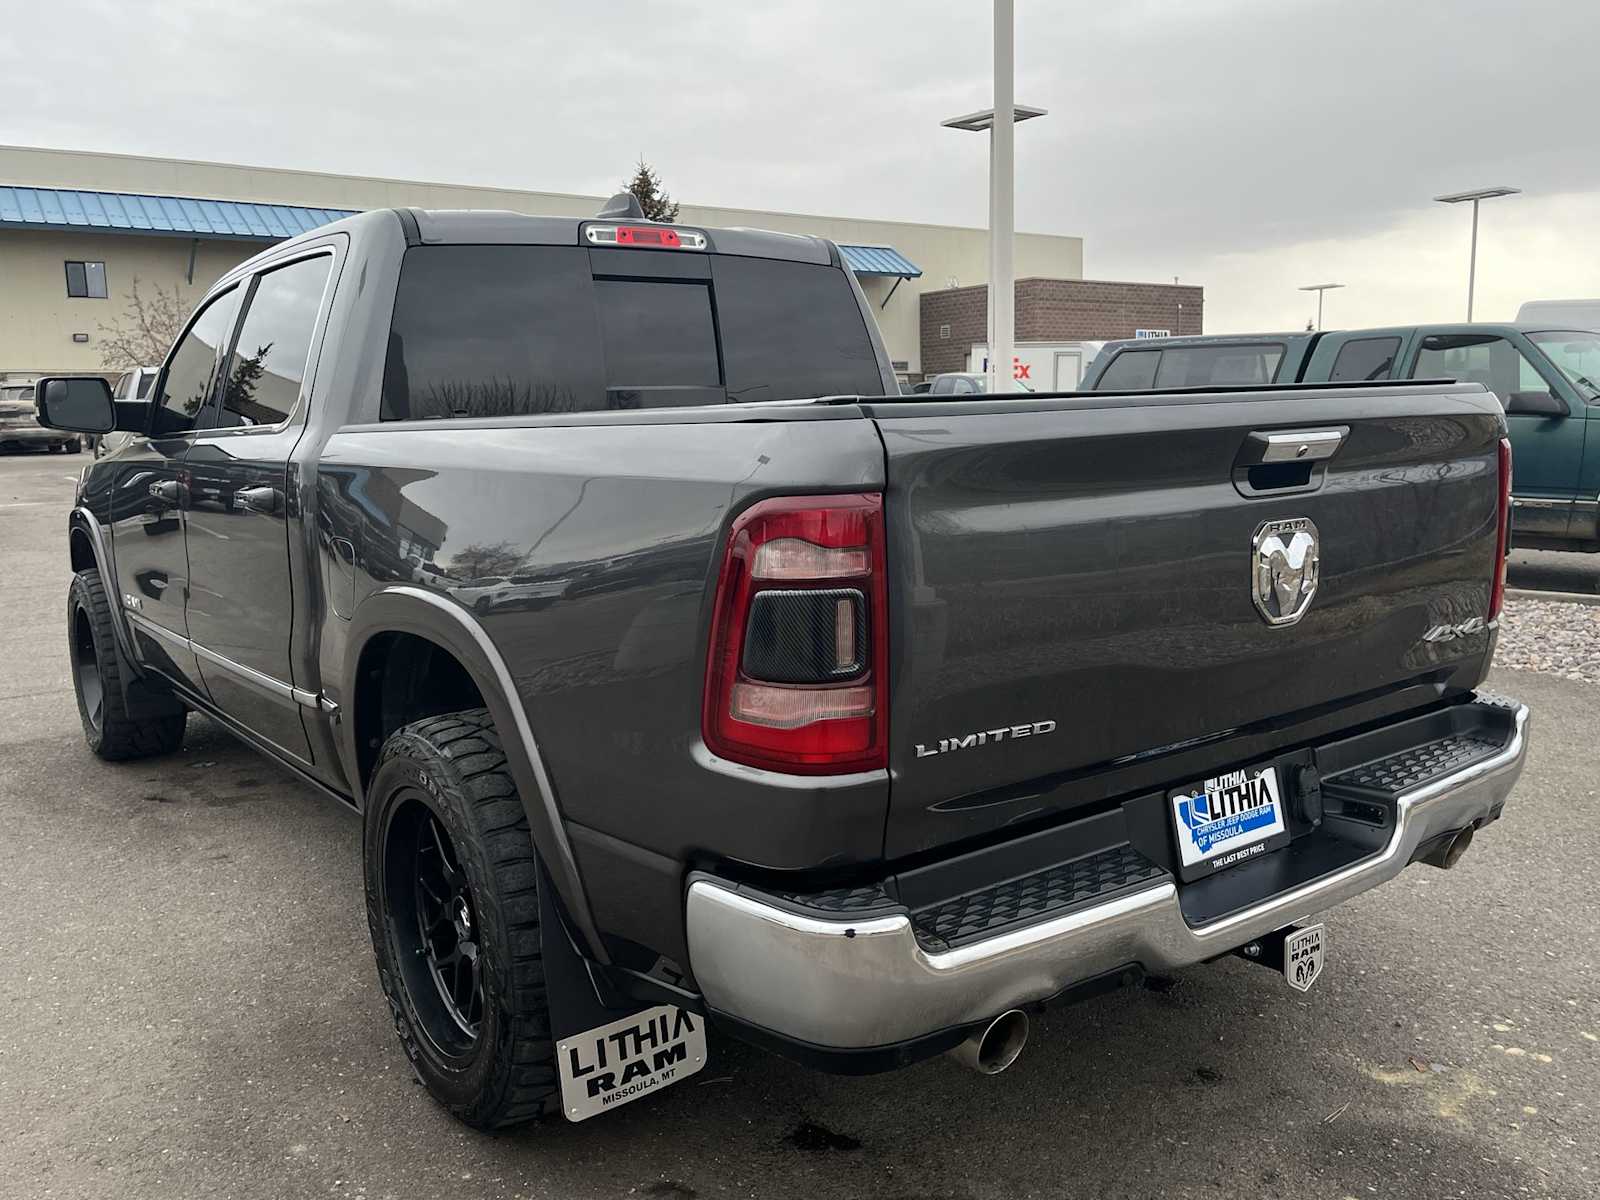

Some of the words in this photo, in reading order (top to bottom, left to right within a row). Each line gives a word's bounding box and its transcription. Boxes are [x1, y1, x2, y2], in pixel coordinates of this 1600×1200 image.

[1270, 520, 1306, 532] RAM
[914, 719, 1056, 758] LIMITED
[1214, 769, 1248, 791] LITHIA
[1208, 777, 1273, 821] LITHIA
[1197, 819, 1226, 836] CHRYSLER
[1226, 815, 1240, 827] JEEP
[1240, 809, 1260, 821] DODGE
[1259, 805, 1272, 815] RAM
[1198, 835, 1208, 847] OF
[1208, 824, 1244, 844] MISSOULA
[1212, 858, 1224, 869] THE
[1223, 853, 1237, 865] LAST
[1236, 848, 1250, 860] BEST
[1249, 842, 1265, 855] PRICE
[1291, 943, 1320, 962] RAM
[1292, 932, 1320, 952] LITHIA
[569, 1008, 695, 1078] LITHIA
[586, 1041, 687, 1098] RAM
[602, 1077, 660, 1106] MISSOULA,
[661, 1068, 677, 1082] MT
